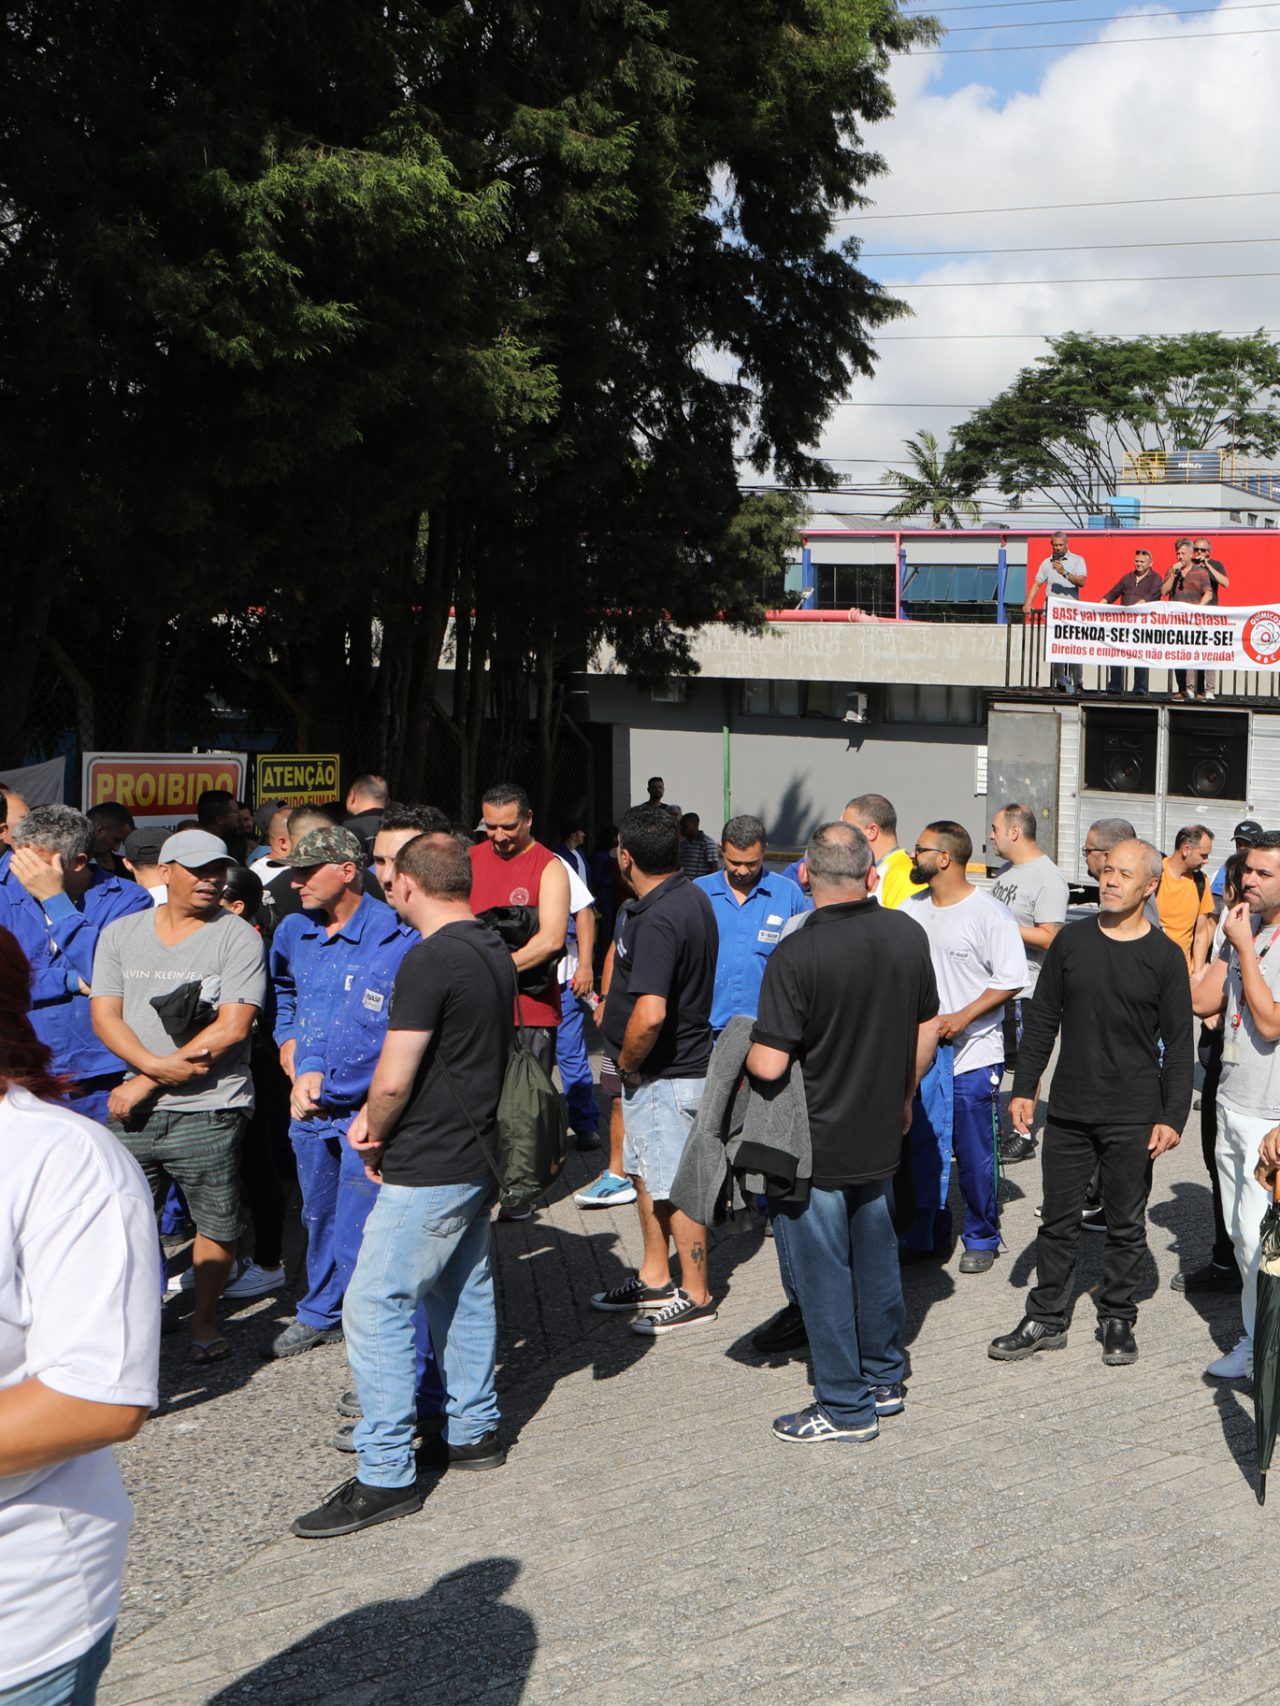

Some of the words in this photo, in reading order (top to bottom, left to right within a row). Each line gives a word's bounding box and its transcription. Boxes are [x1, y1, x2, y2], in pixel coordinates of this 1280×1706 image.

[1053, 607, 1078, 620] BASF
[1080, 609, 1097, 622] vai
[1098, 611, 1139, 624] vender
[1141, 612, 1148, 624] a
[1054, 625, 1130, 643] DEFENDA-SE!
[1132, 628, 1234, 646] SINDICALIZE-SE!
[1051, 643, 1087, 656] Direitos
[1089, 646, 1095, 656] e
[1096, 647, 1144, 659] empregos
[1145, 648, 1163, 660] não
[1165, 648, 1192, 661] estão
[1202, 650, 1235, 662] venda!
[262, 761, 336, 791] ATENÇÃO
[96, 772, 234, 807] PROIBIDO
[154, 969, 184, 980] KLEIN
